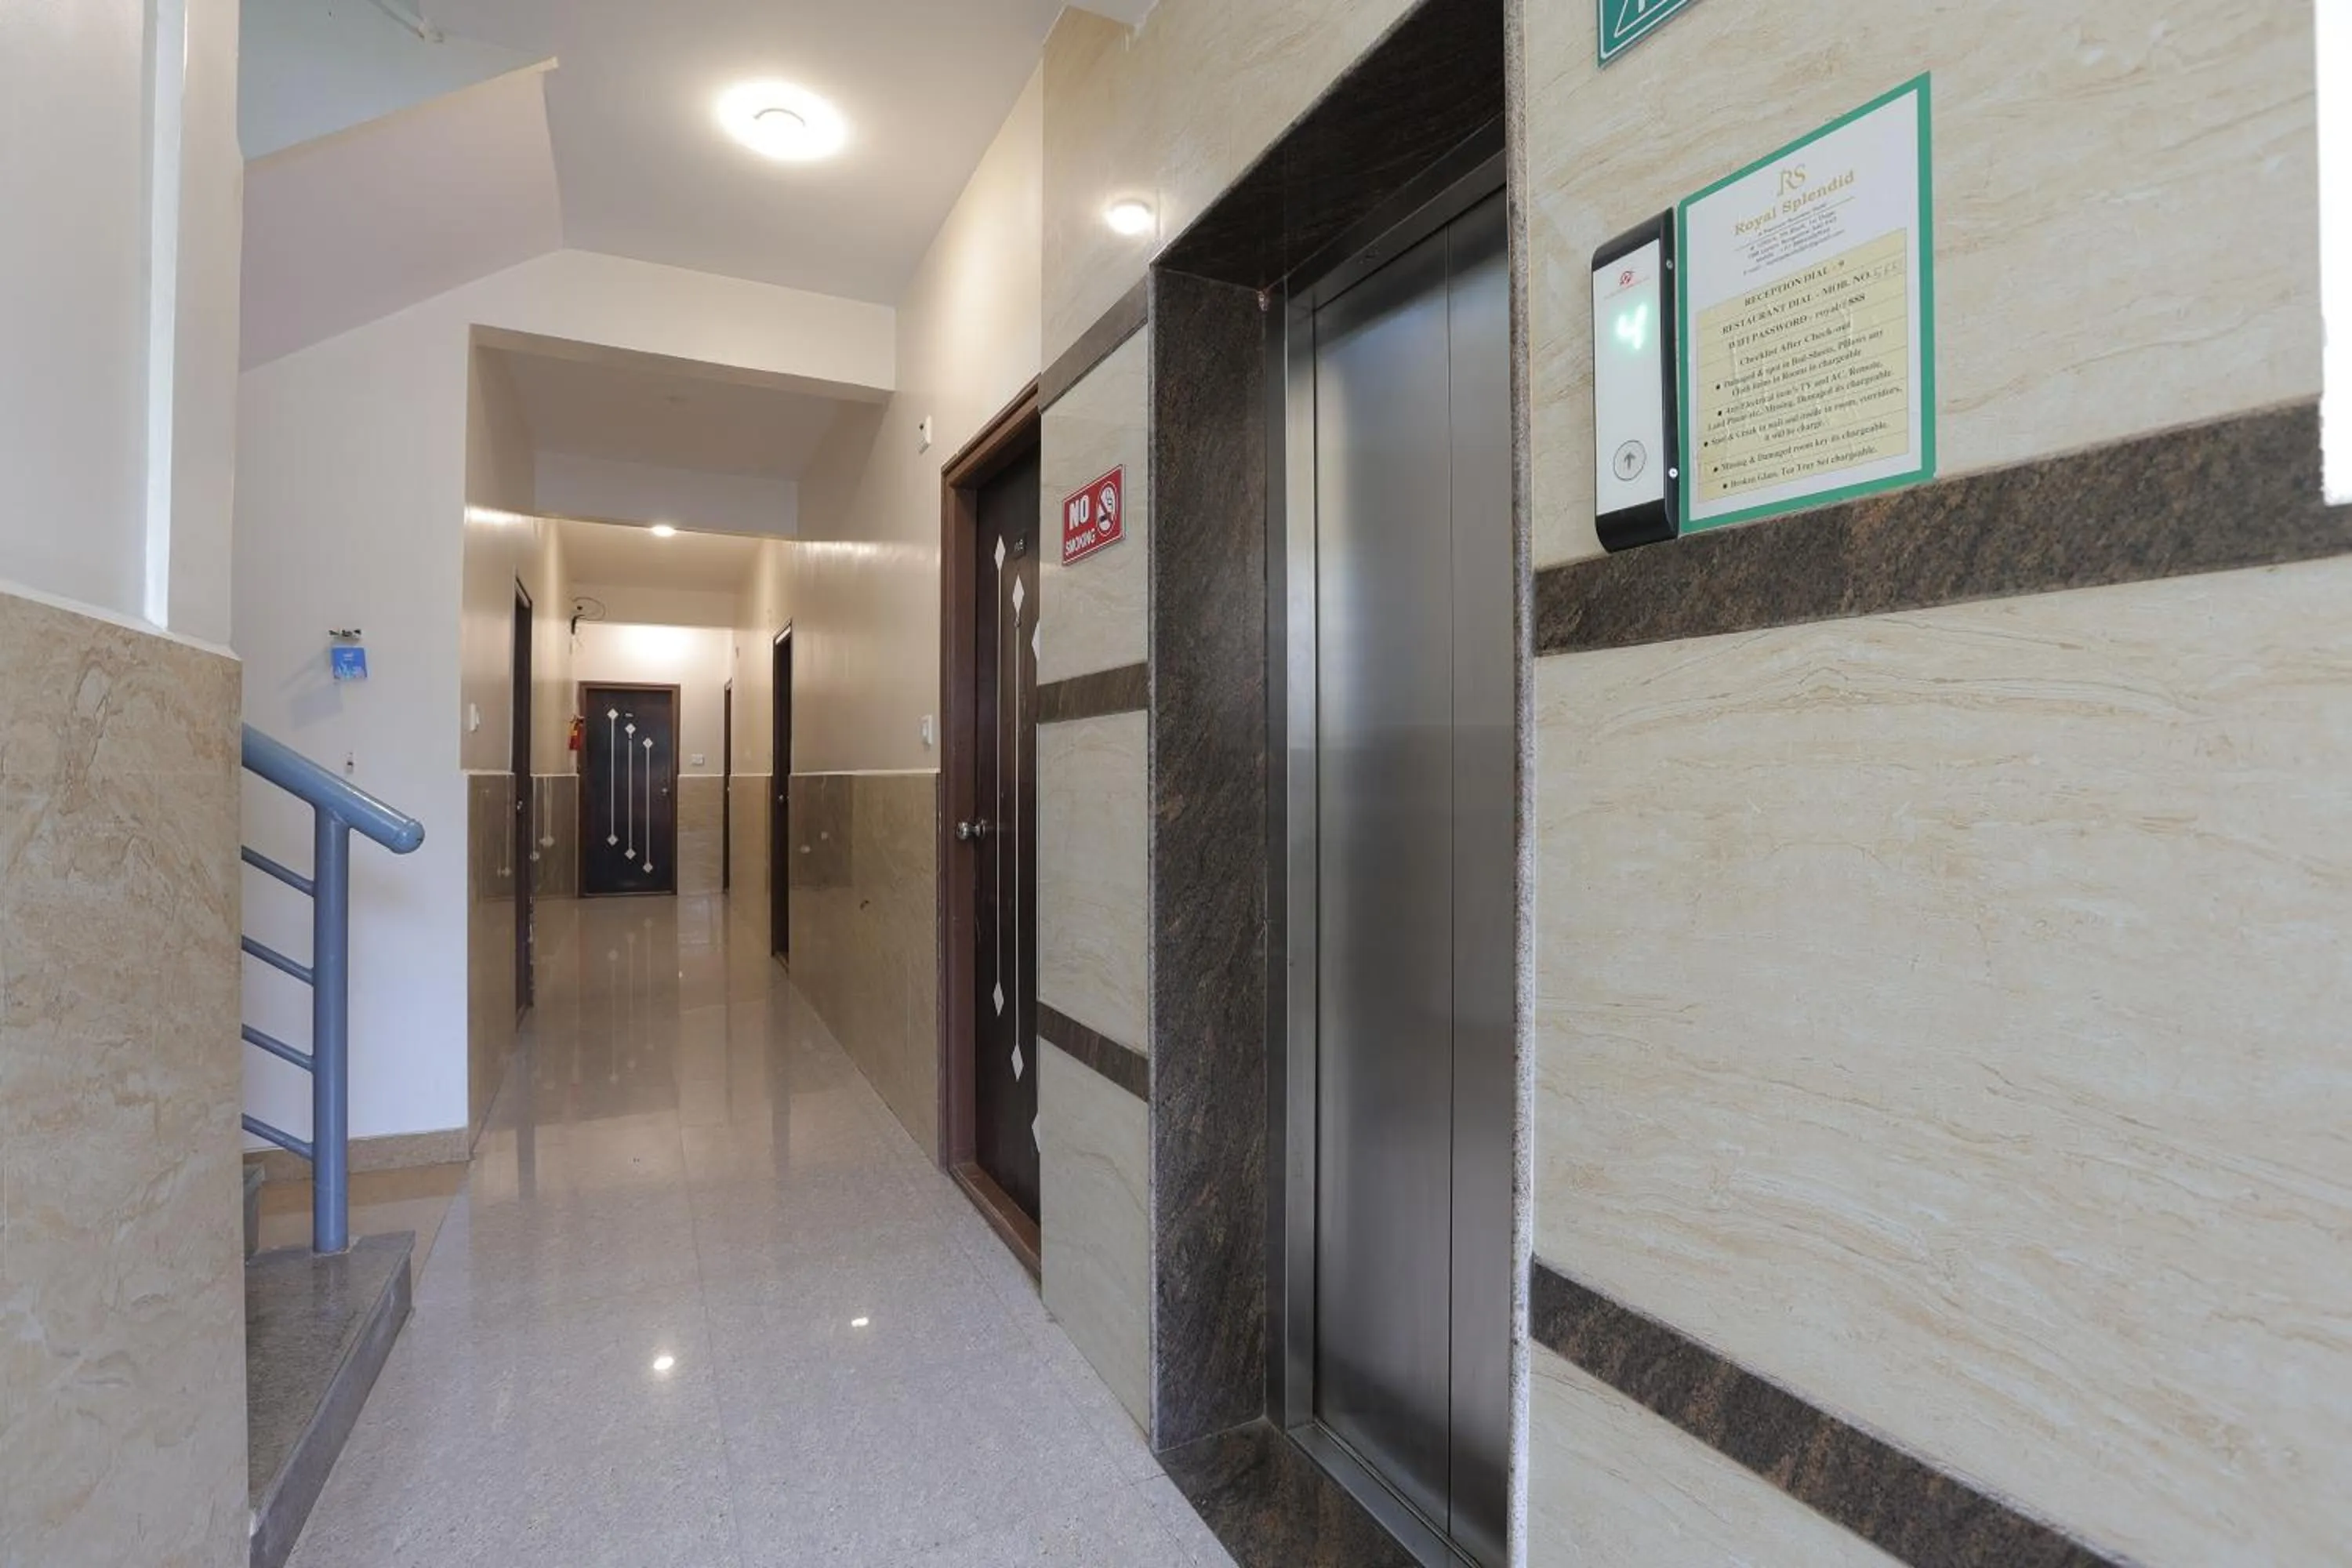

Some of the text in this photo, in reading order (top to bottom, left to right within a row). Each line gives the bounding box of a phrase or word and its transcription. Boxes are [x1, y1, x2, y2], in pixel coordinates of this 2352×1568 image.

[1734, 204, 1777, 236] Royal
[1782, 170, 1856, 216] Splendid
[1744, 276, 1801, 307] RECEPTION
[1803, 265, 1827, 283] DIAL
[1617, 301, 1647, 350] 4
[1722, 302, 1787, 335] RESTAURANT
[1751, 313, 1807, 342] PASSWORD
[1069, 495, 1090, 531] NO
[1066, 528, 1096, 555] SMOKING
